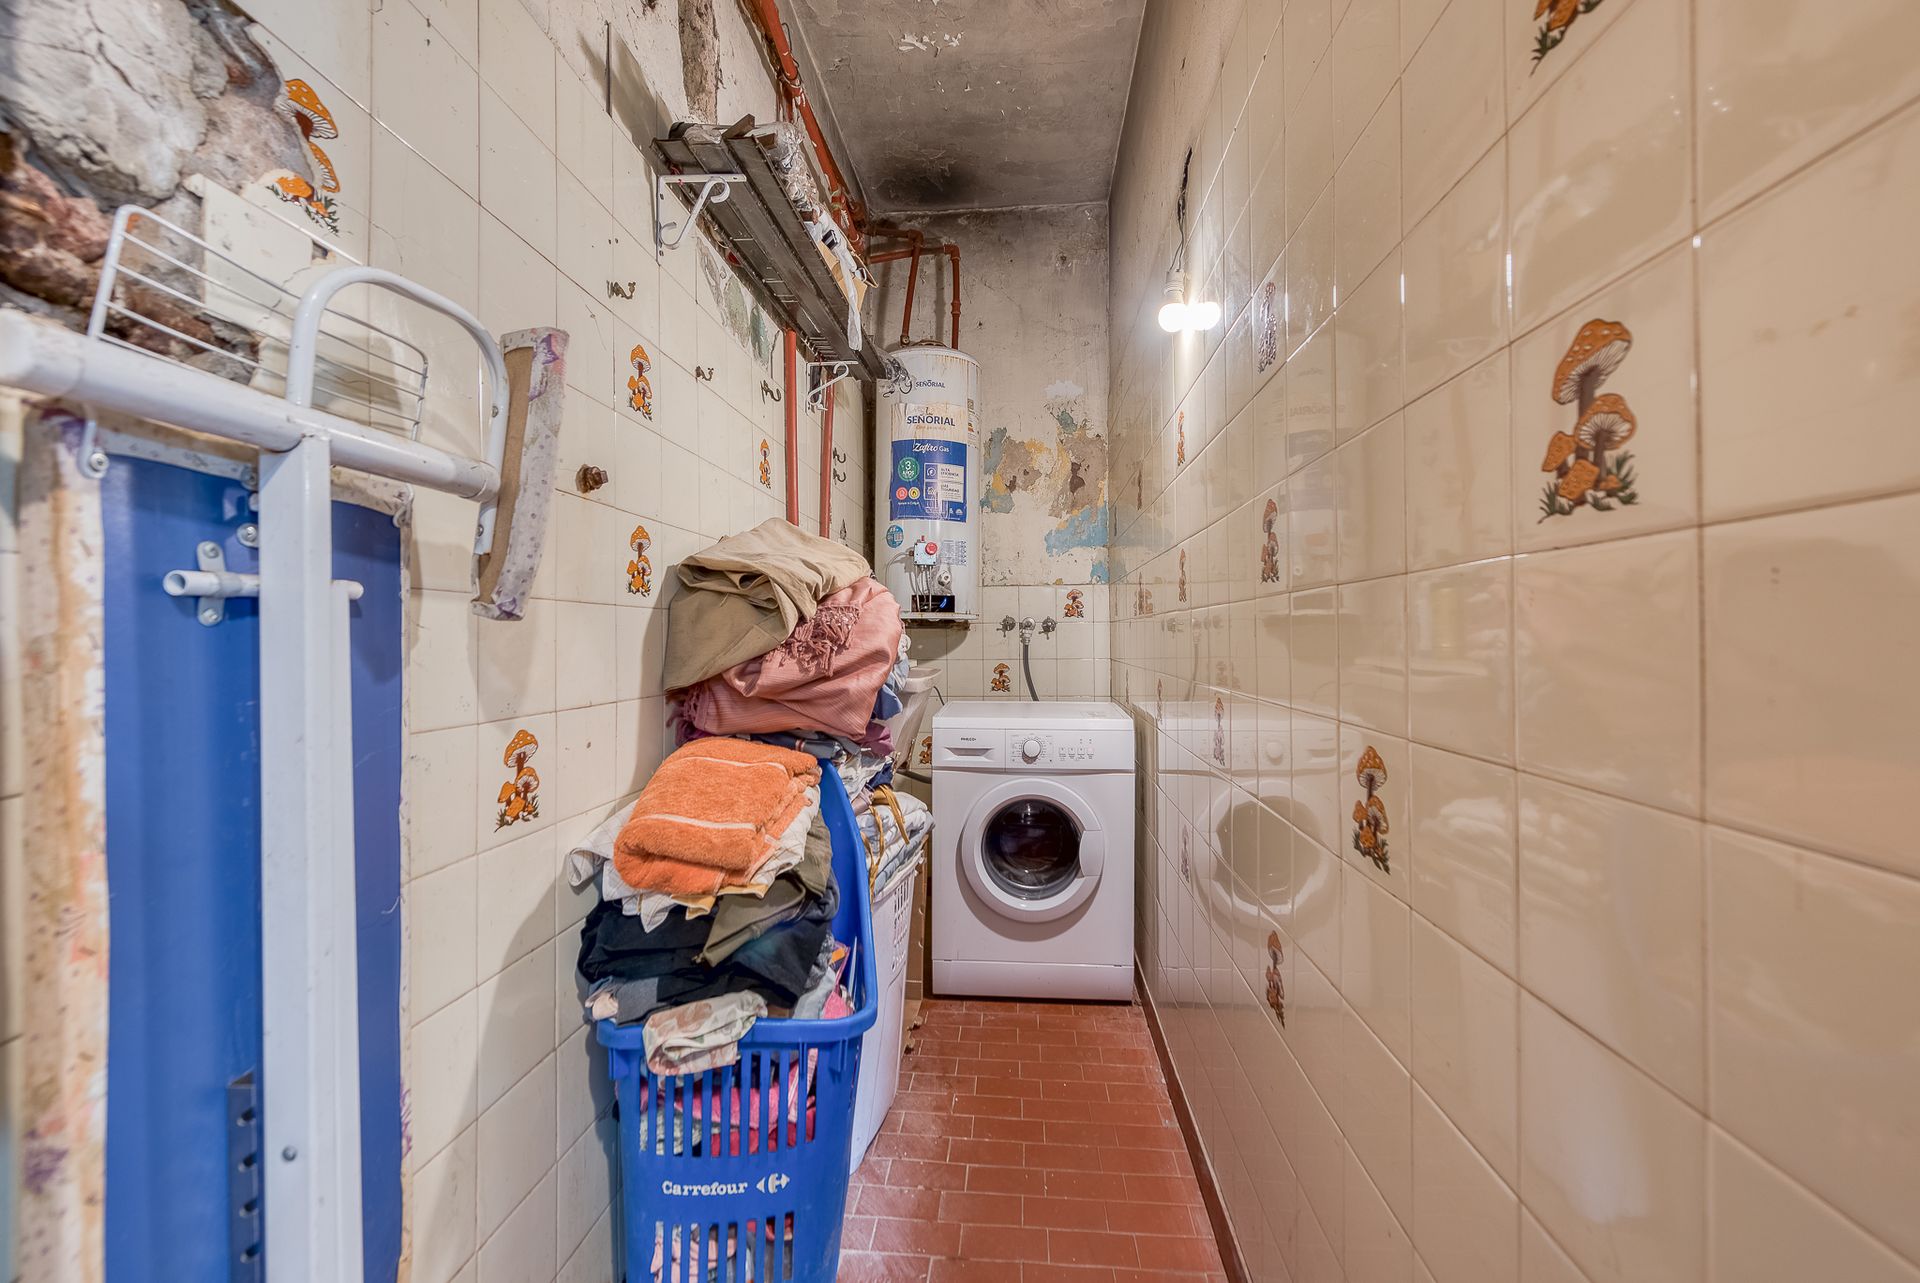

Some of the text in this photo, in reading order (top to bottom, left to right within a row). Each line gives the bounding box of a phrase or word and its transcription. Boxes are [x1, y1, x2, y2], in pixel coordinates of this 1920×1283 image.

[915, 380, 945, 388] SEÑORIAL
[907, 414, 956, 427] SEÑORIAL
[912, 442, 938, 453] Zafiro
[905, 460, 912, 470] 3
[661, 1180, 748, 1196] Carrefour
